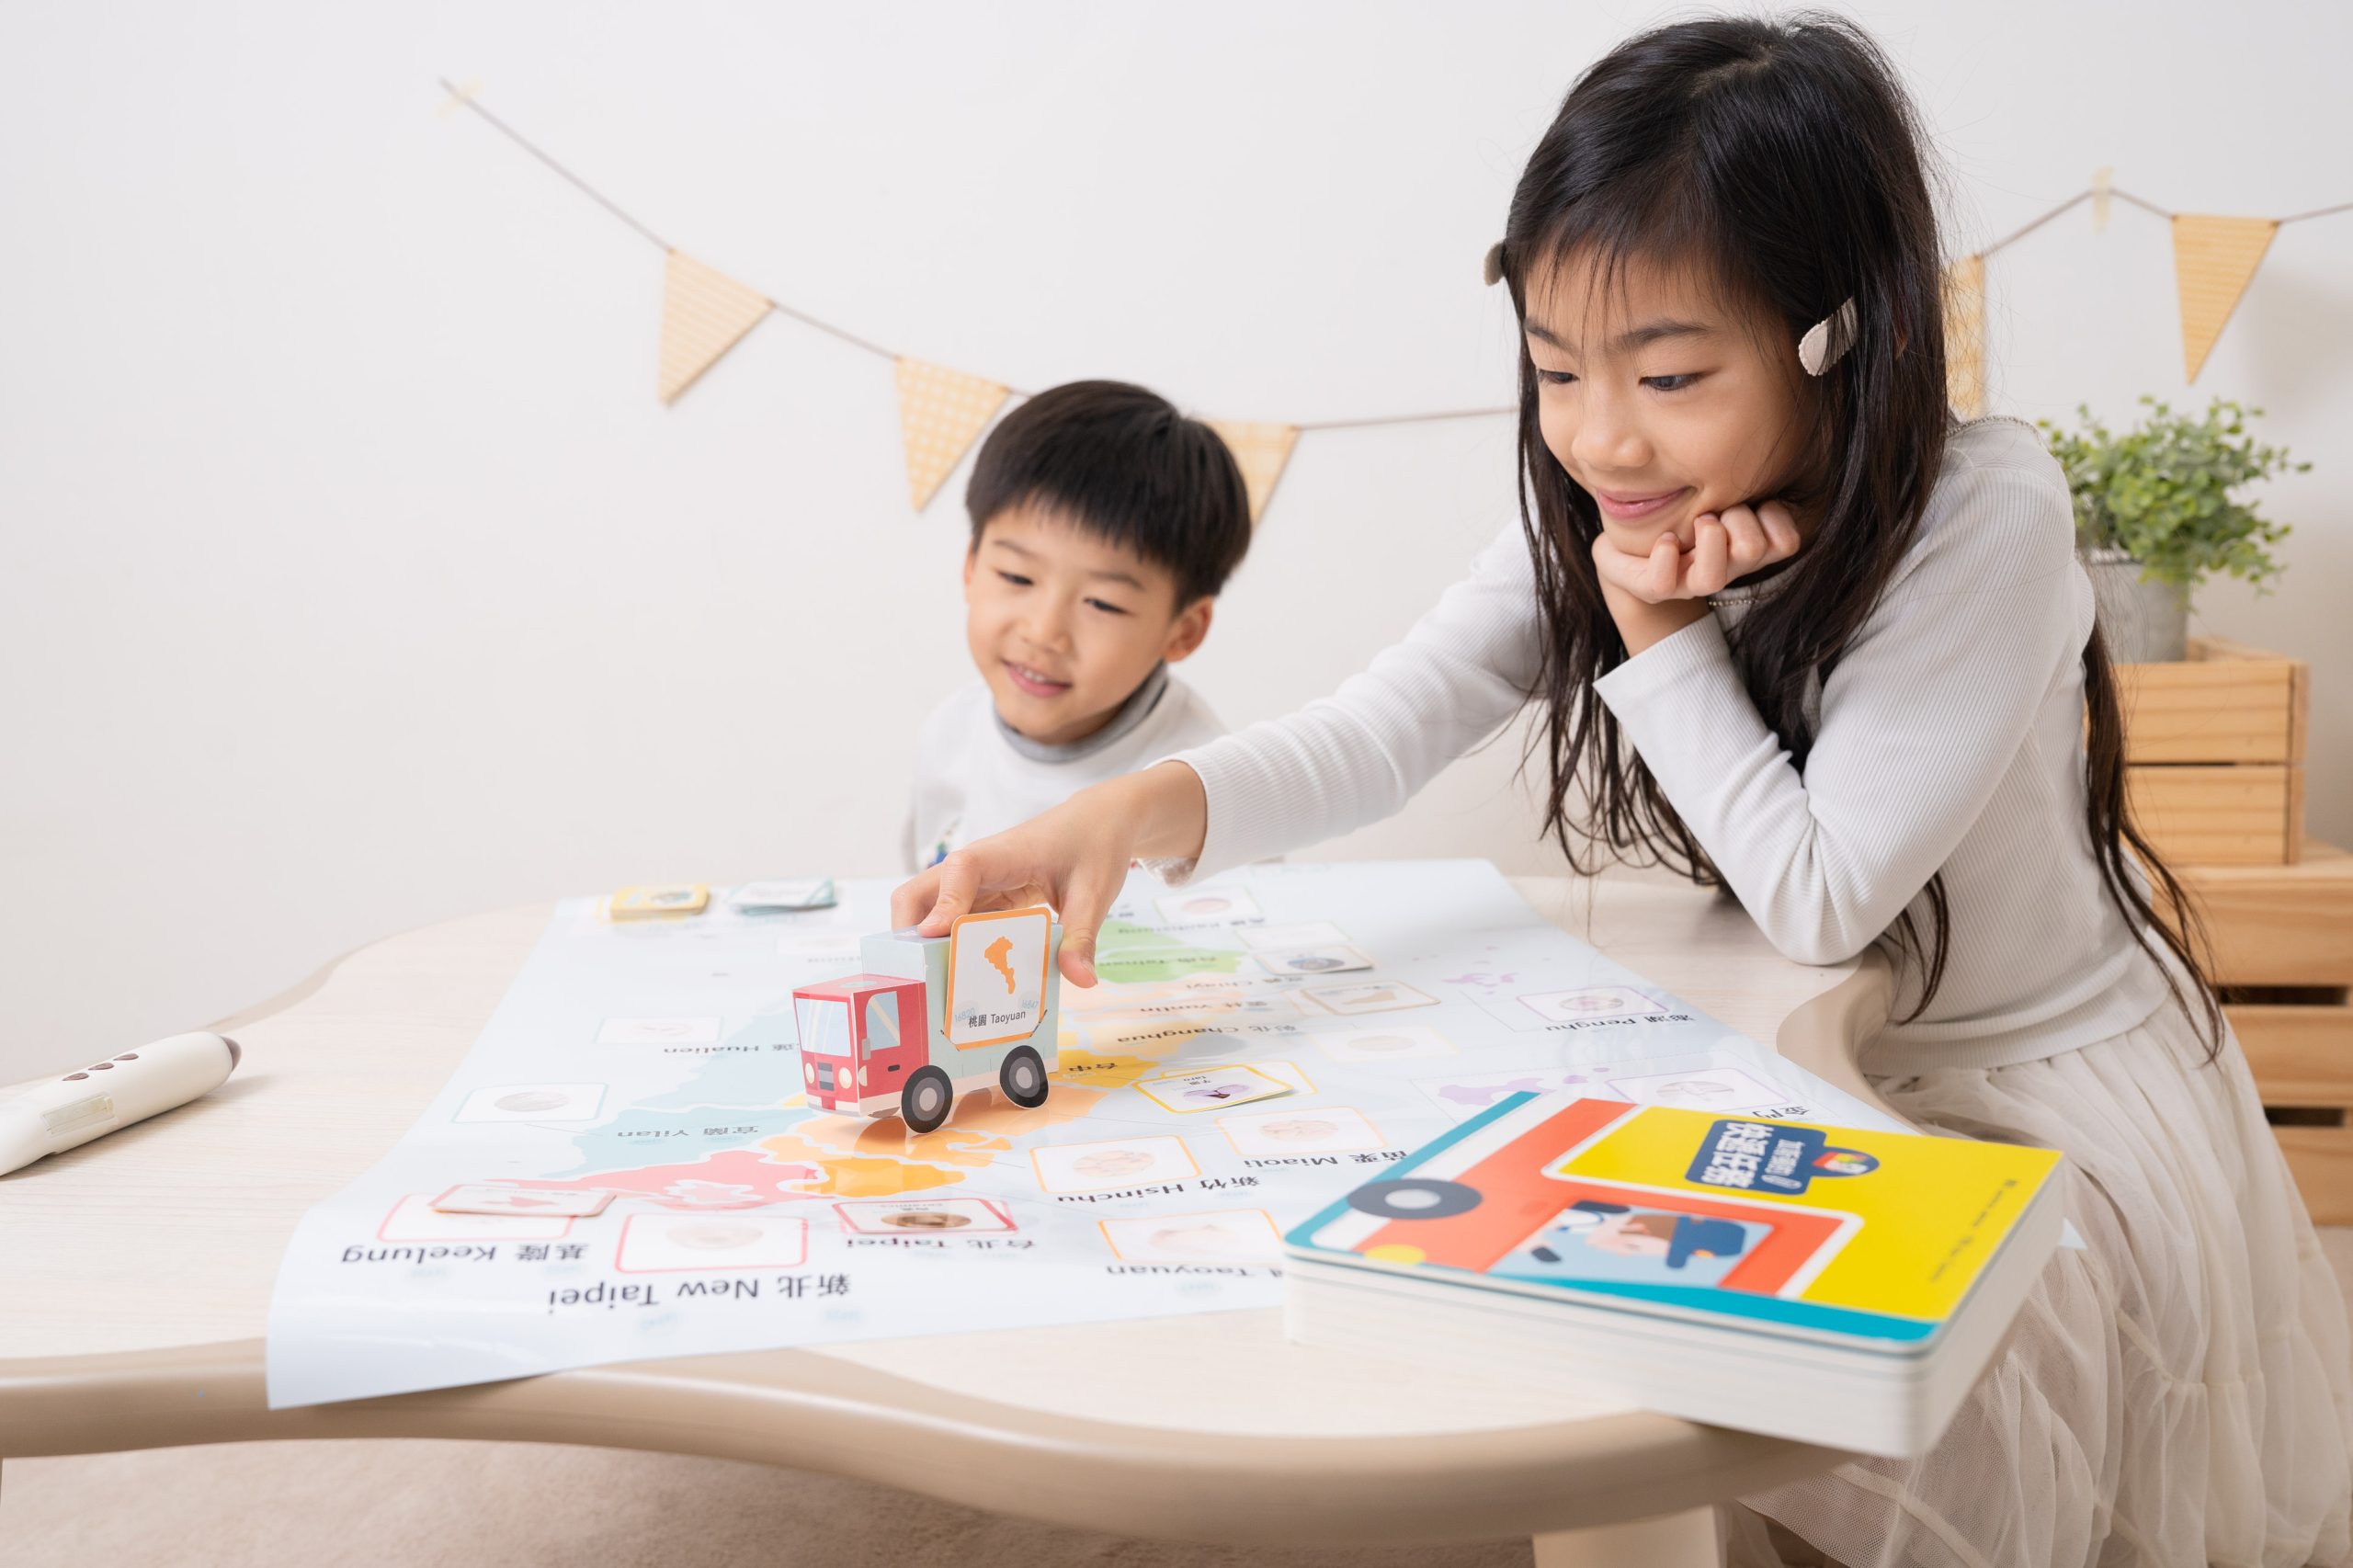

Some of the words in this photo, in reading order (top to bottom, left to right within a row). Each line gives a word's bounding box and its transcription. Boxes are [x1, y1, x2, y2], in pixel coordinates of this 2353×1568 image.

[968, 1014, 987, 1028] 桃園
[991, 1011, 1027, 1025] Taoyuan
[1545, 1017, 1637, 1031] Penghu
[1117, 1026, 1240, 1043] Changhua
[664, 1044, 760, 1054] Hualien
[1068, 1062, 1119, 1073] 台中
[617, 1129, 690, 1139] Yilan
[1244, 1155, 1340, 1169] Miaoli
[1348, 1150, 1409, 1165] 苗栗
[1199, 1176, 1261, 1190] 新竹
[1056, 1183, 1186, 1203] Hsinchu
[847, 1237, 952, 1249] Taipei
[966, 1238, 1039, 1250] 台北
[340, 1244, 497, 1265] Keelung
[516, 1243, 589, 1262] 基隆
[1105, 1264, 1256, 1277] Taoyuan
[676, 1277, 760, 1300] New
[778, 1273, 851, 1299] 新北
[548, 1280, 660, 1315] Taipei
